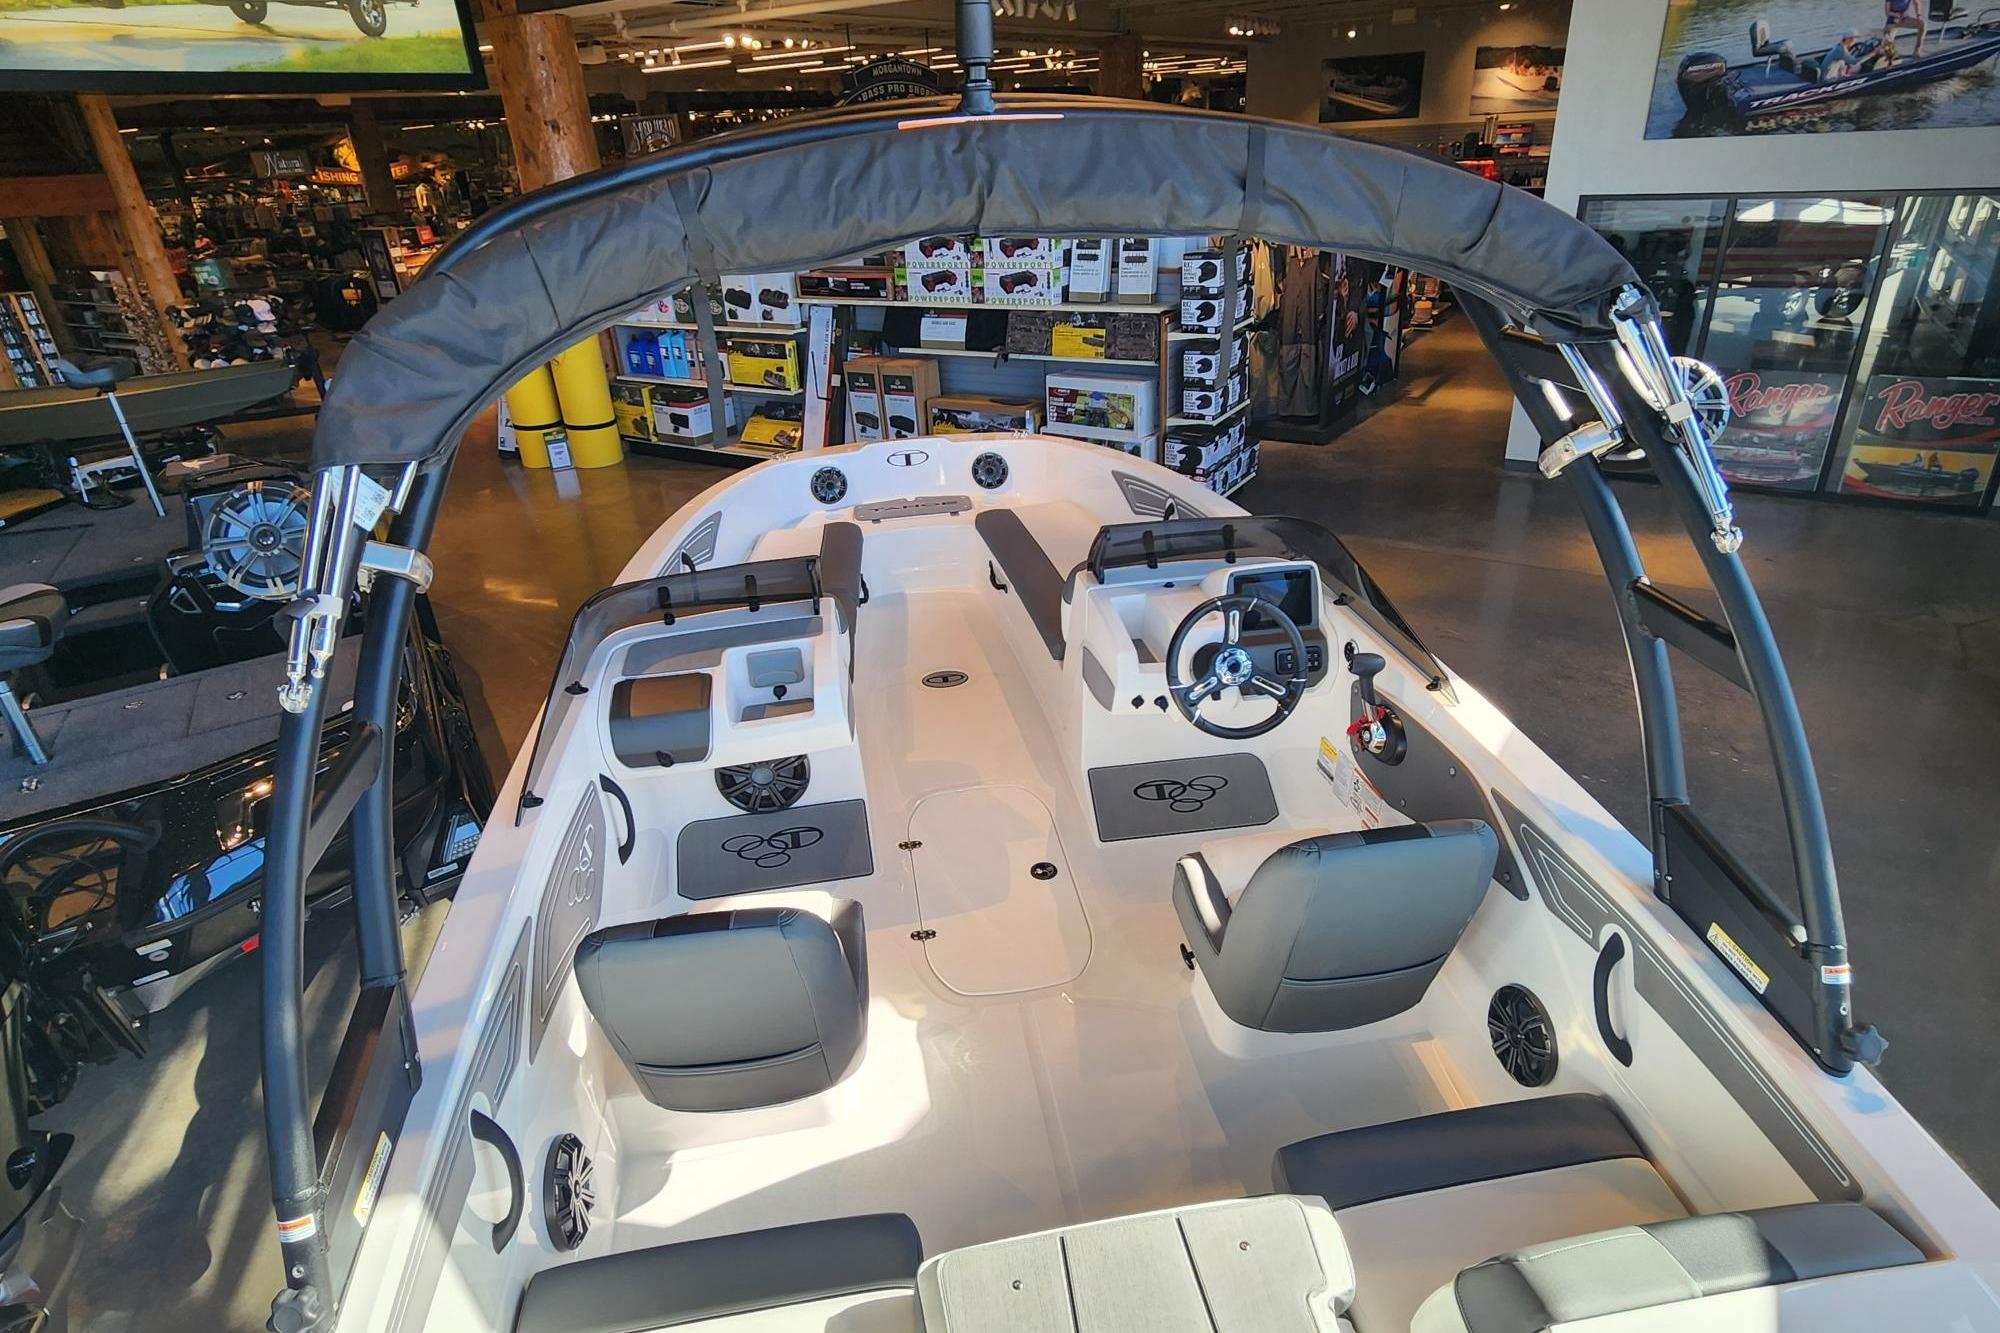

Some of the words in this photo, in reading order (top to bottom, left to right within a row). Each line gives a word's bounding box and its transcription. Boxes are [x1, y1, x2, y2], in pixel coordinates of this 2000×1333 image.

[872, 65, 922, 77] MORGANTOWN
[861, 85, 885, 101] BASS
[888, 84, 905, 93] PRO
[1751, 77, 1869, 107] TRACKER
[264, 152, 304, 176] Natural
[318, 170, 359, 183] ISHING
[391, 165, 409, 178] TER
[985, 261, 1053, 269] POWERSPORTS
[909, 295, 972, 303] POWERSPORTS
[985, 297, 1052, 305] POWERSPORTS
[1725, 372, 1829, 417] Ranger
[1876, 380, 2000, 433] Ranger
